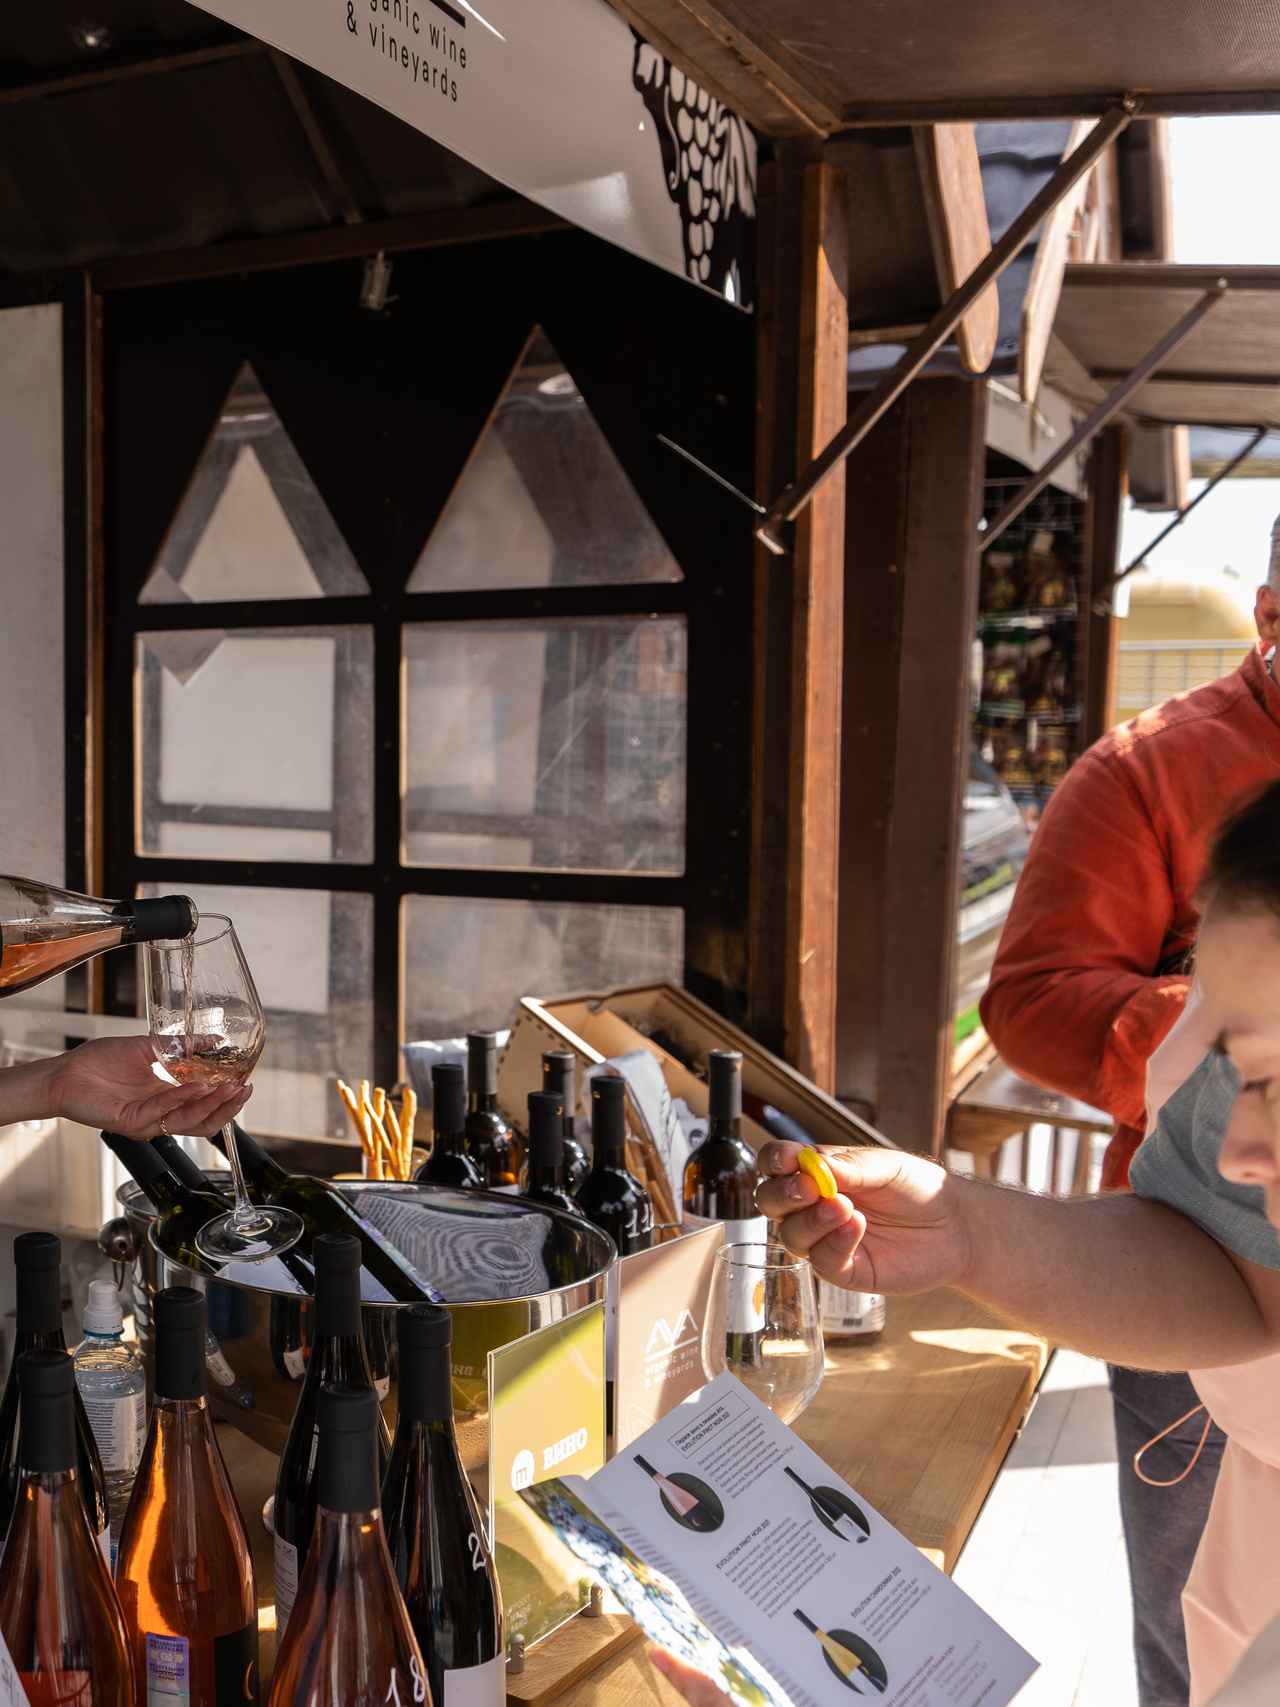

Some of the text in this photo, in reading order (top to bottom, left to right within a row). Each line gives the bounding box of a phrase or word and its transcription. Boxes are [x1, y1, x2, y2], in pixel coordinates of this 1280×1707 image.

[346, 1, 457, 102] & vineyards
[429, 23, 466, 69] wine
[645, 1308, 699, 1352] AYA
[654, 1360, 694, 1384] vineyards
[680, 1346, 699, 1360] wine
[543, 1428, 588, 1471] ВИНО
[681, 1433, 704, 1452] EVOLUTION
[702, 1423, 714, 1435] PINOT
[716, 1545, 741, 1570] EVOLUTION
[739, 1535, 752, 1548] PINOT
